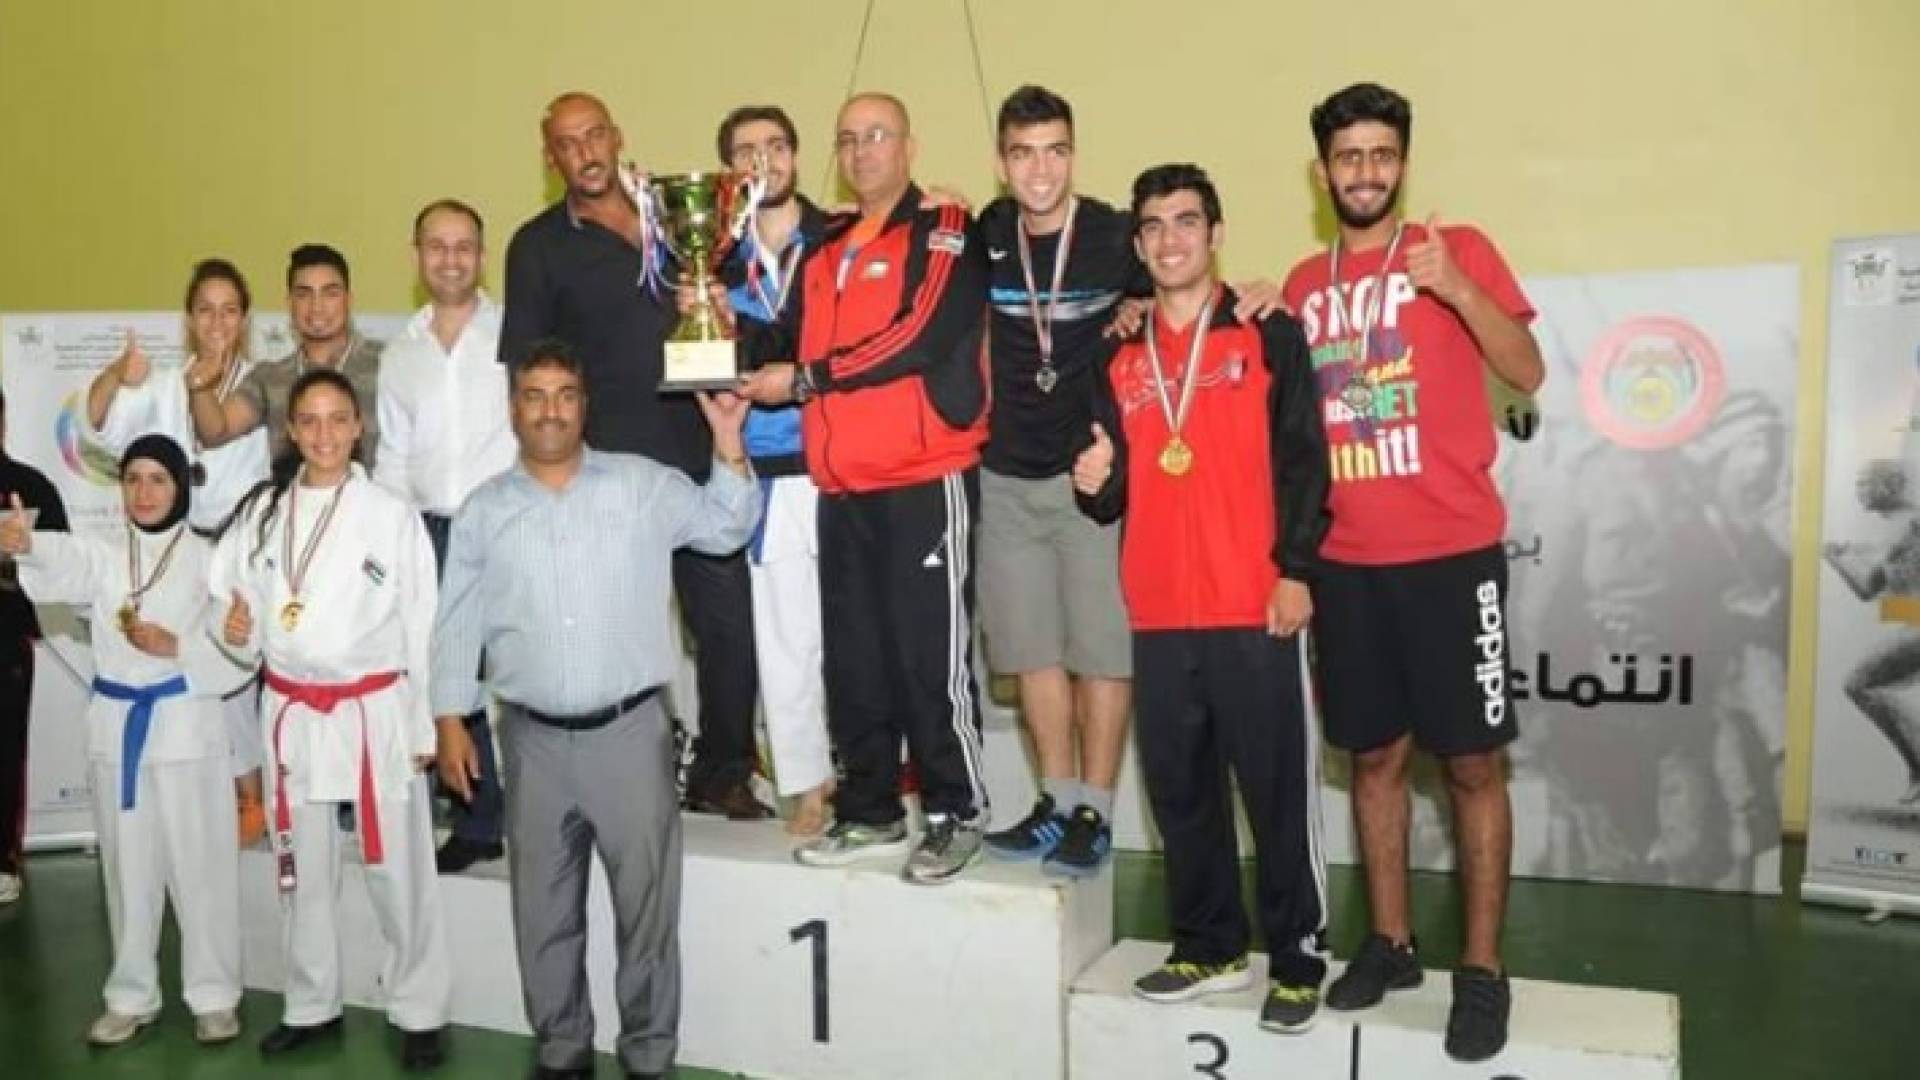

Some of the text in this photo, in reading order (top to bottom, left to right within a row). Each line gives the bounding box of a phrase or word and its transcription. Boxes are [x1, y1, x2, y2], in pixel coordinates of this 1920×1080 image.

[1303, 272, 1417, 346] STOP
[1475, 579, 1505, 727] adidas
[789, 920, 829, 1043] 1
[1186, 1033, 1230, 1080] 3
